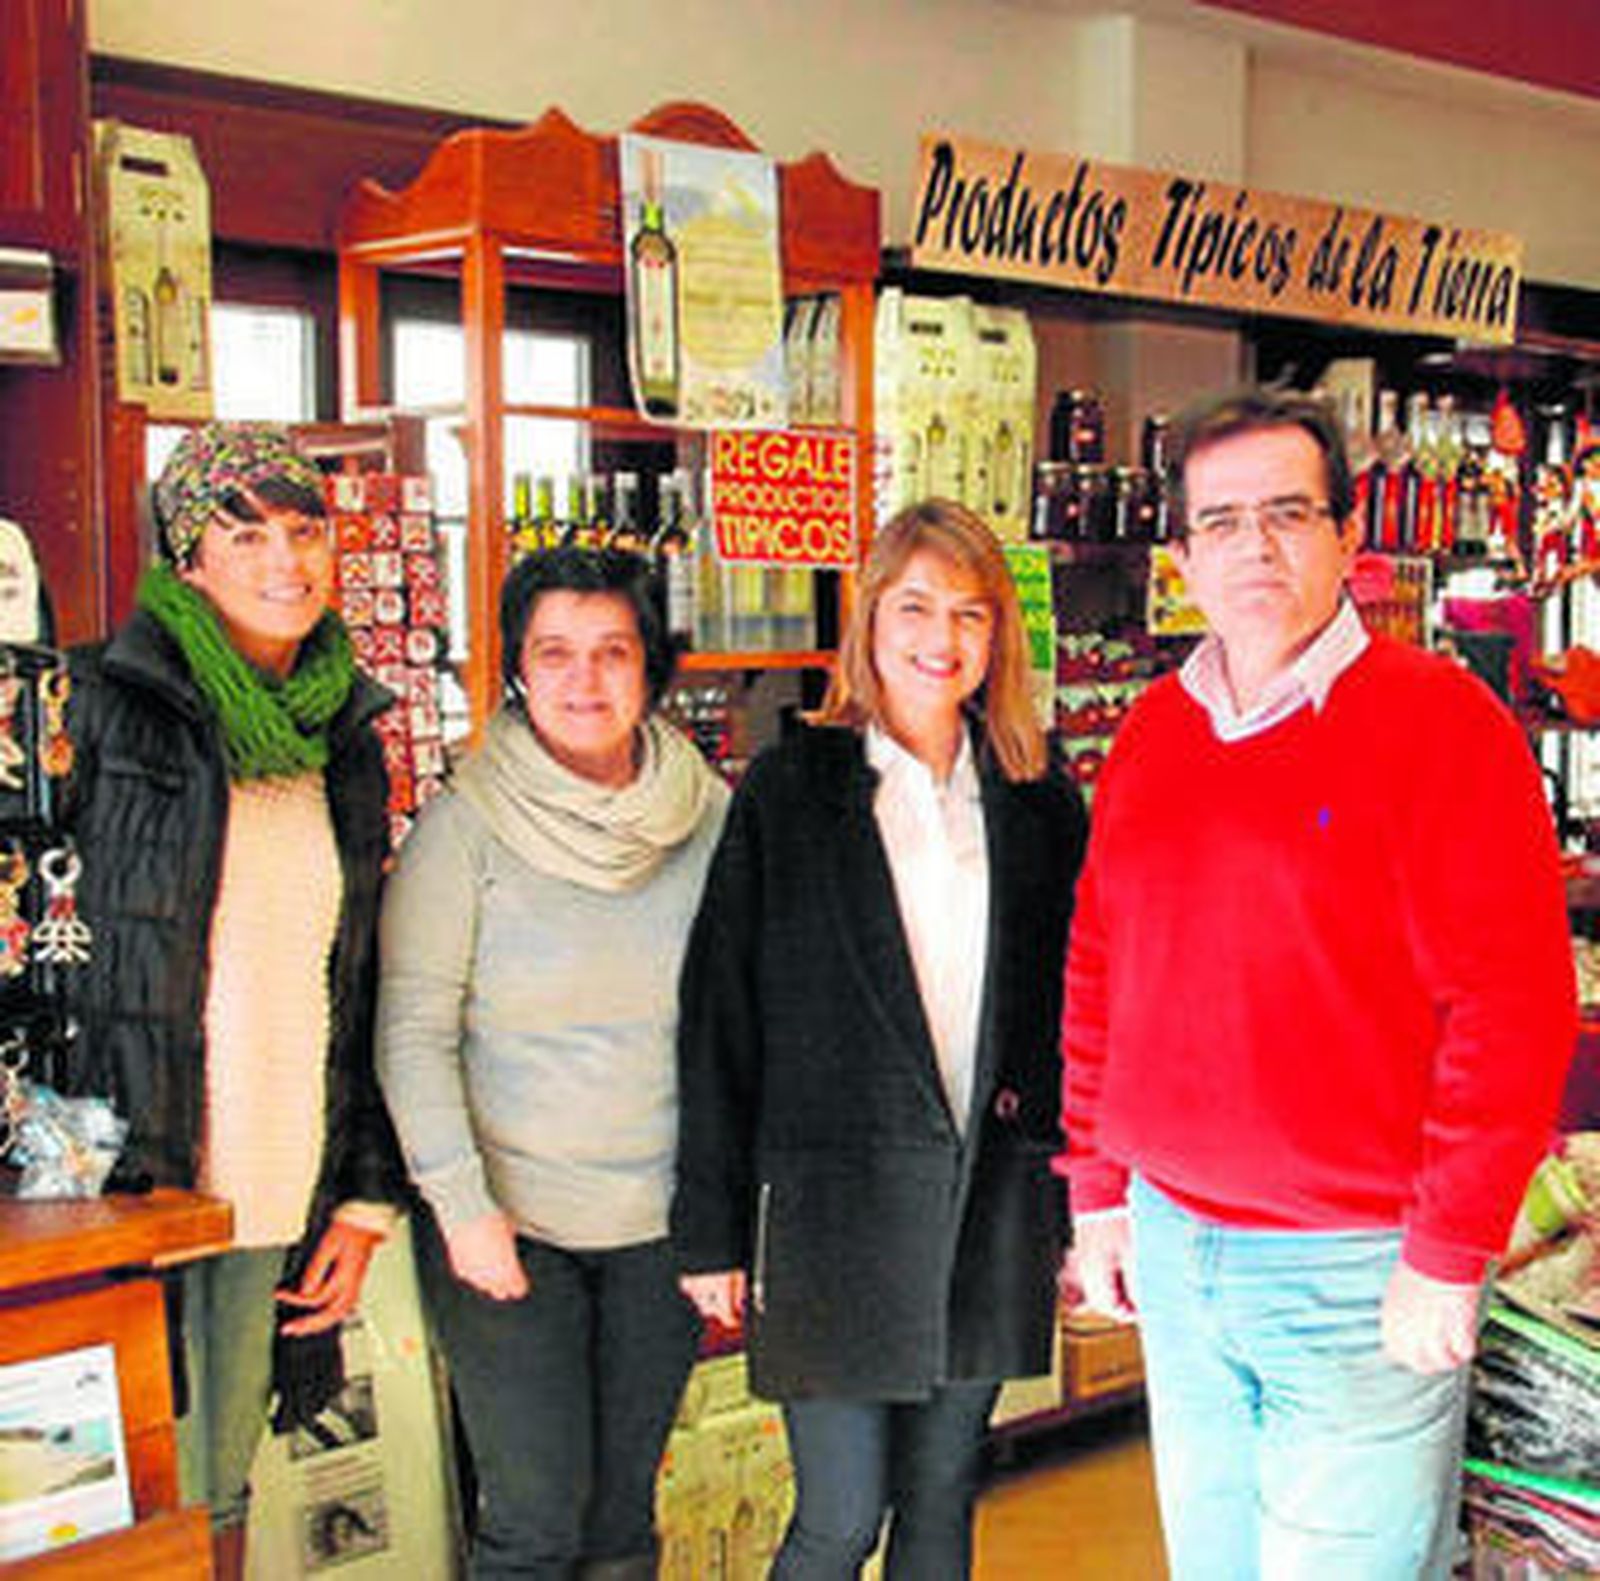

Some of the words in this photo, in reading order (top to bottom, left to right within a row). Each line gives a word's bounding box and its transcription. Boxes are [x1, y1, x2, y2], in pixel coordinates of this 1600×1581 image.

[915, 142, 1127, 284] Productos
[1308, 206, 1350, 292] de
[1351, 215, 1398, 310] la
[1408, 226, 1513, 325] Tierra
[715, 430, 850, 481] REGALE
